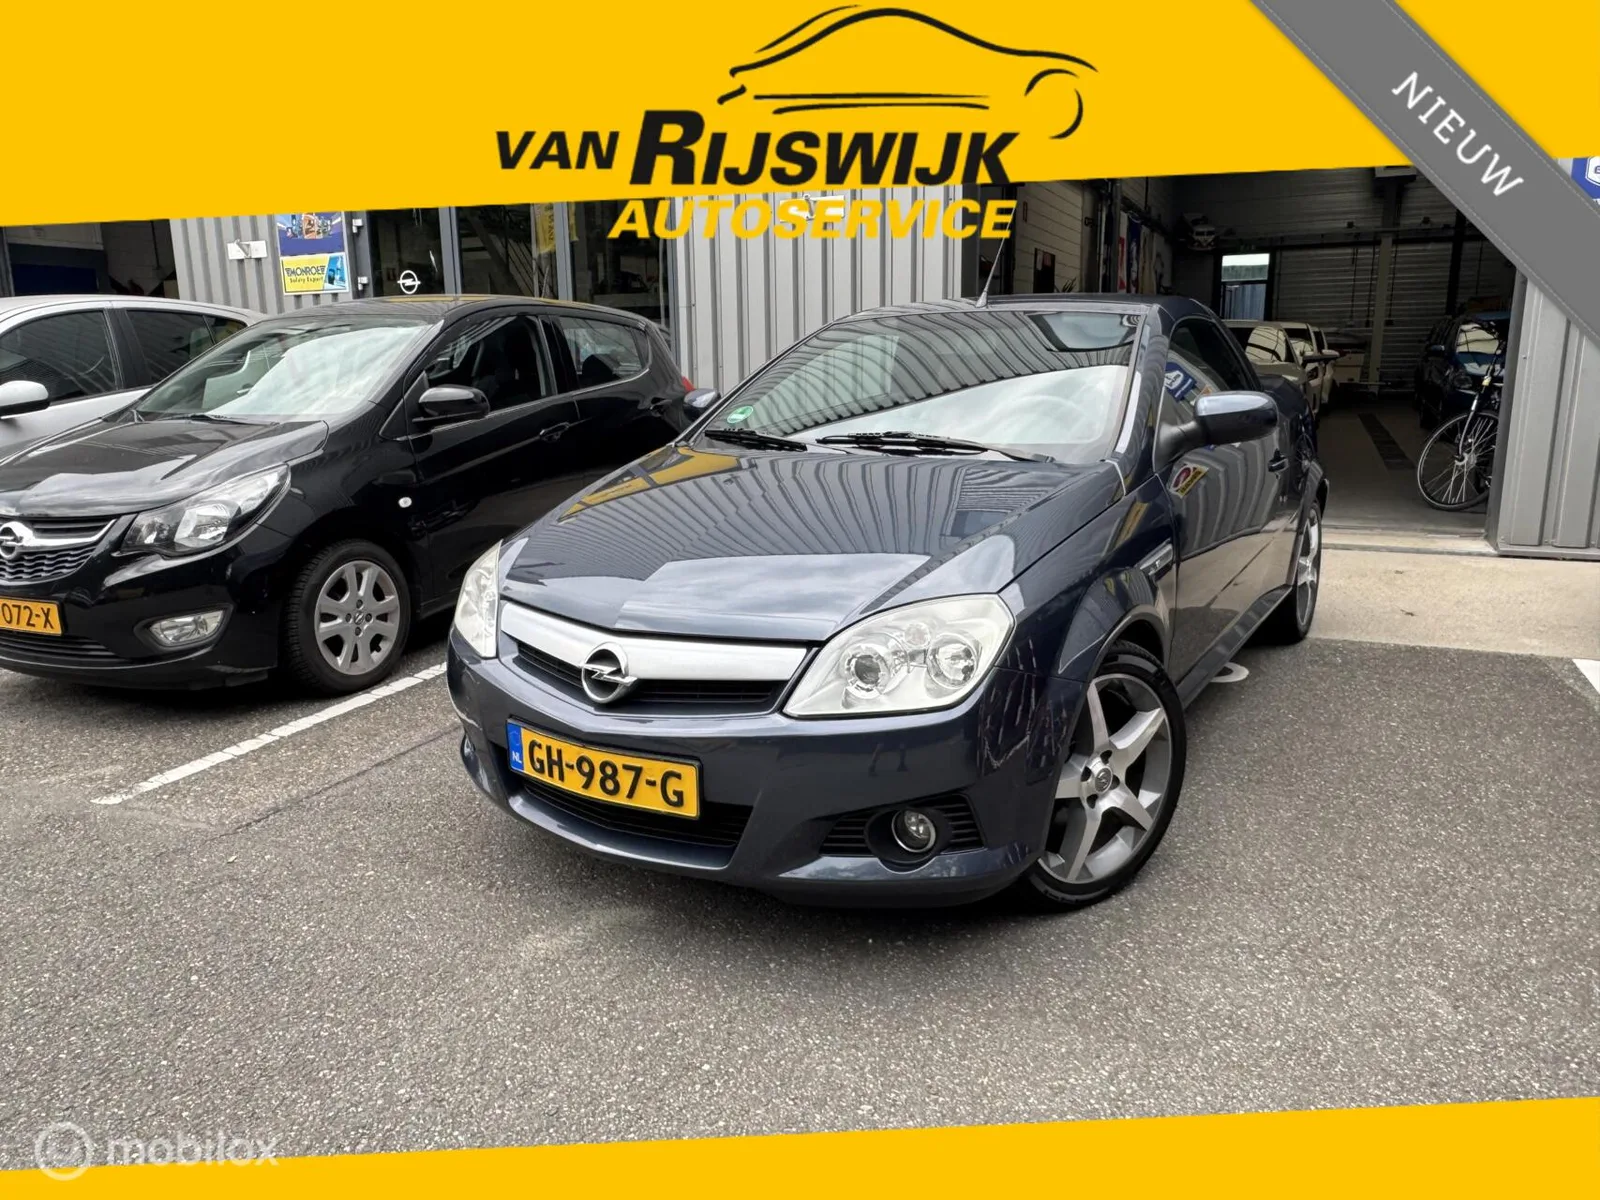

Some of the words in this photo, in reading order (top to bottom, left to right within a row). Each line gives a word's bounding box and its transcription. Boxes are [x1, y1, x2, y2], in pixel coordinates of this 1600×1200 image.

[1, 603, 54, 629] 072-X
[512, 751, 522, 763] NL
[528, 739, 685, 808] GH-987-G
